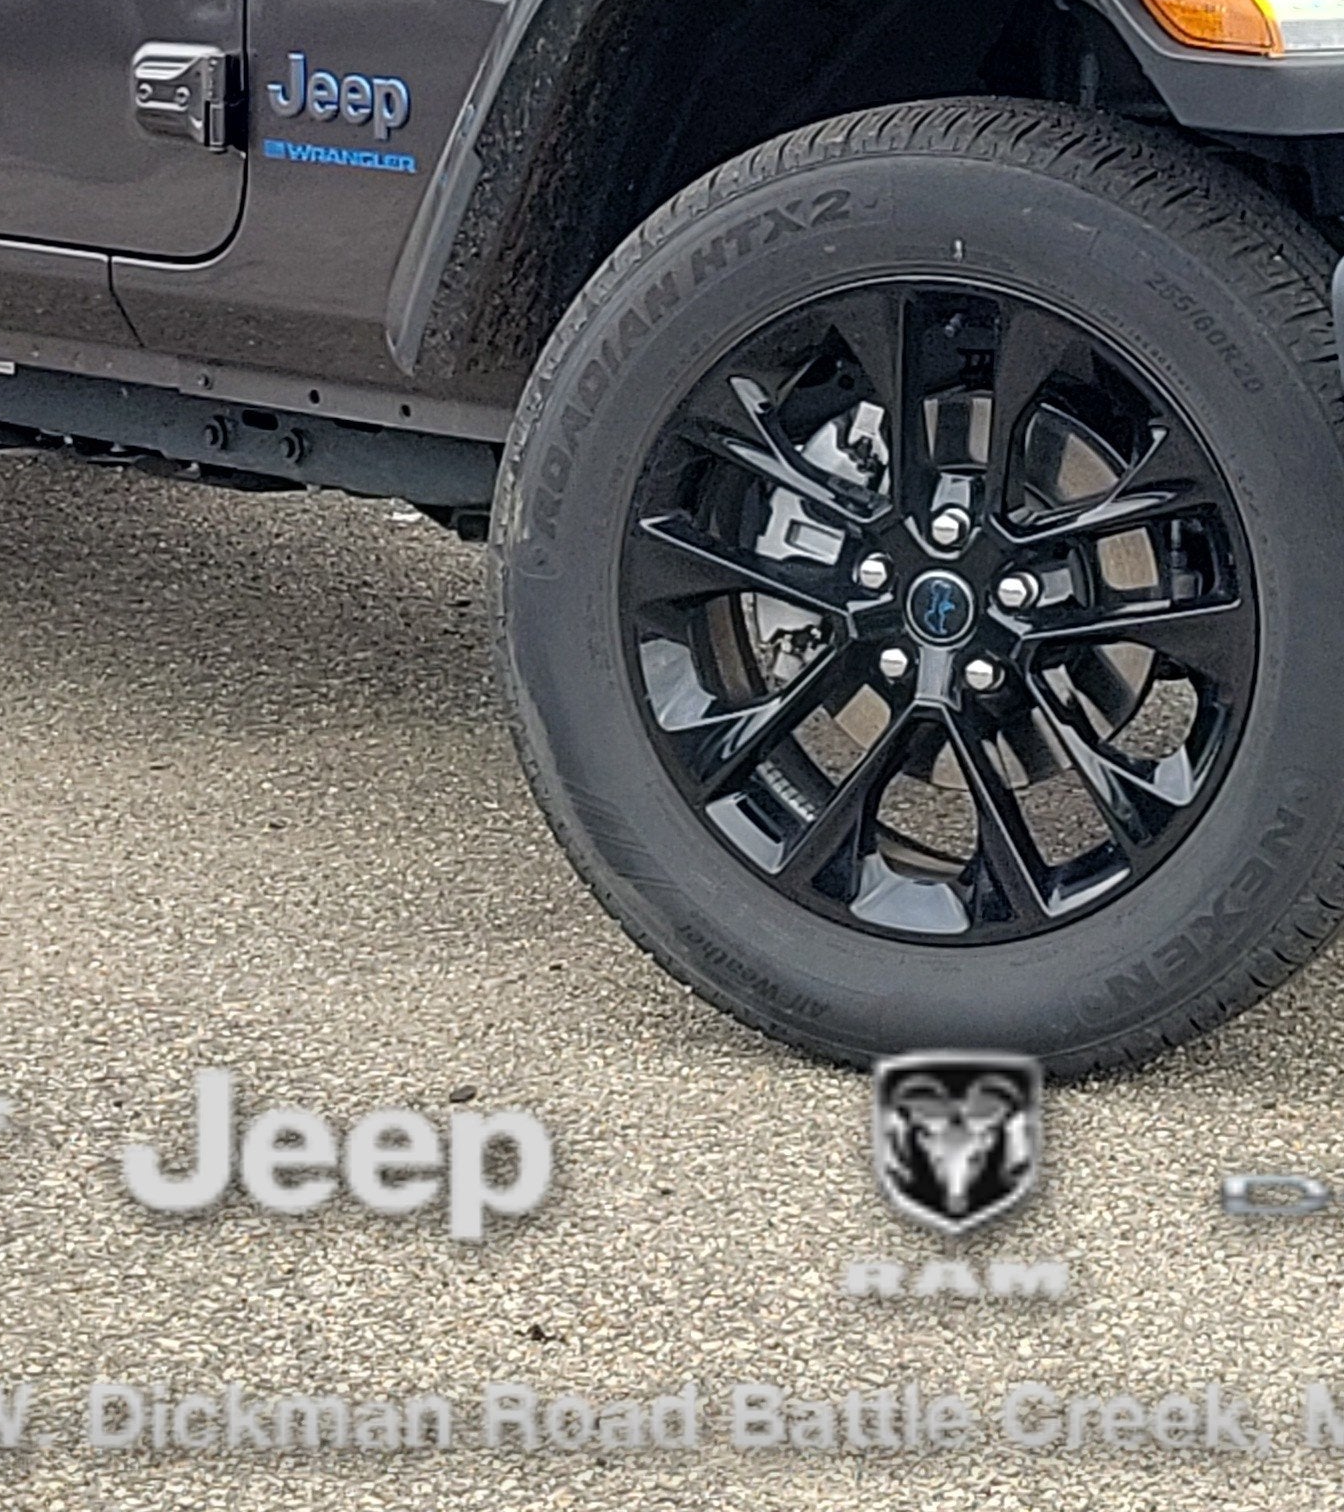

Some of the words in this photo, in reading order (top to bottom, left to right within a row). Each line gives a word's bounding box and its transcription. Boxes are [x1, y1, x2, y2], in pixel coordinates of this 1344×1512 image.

[266, 51, 410, 141] Jeep
[286, 141, 417, 174] WRANGLER
[690, 188, 853, 287] HTX2
[1106, 804, 1307, 999] NEXEN
